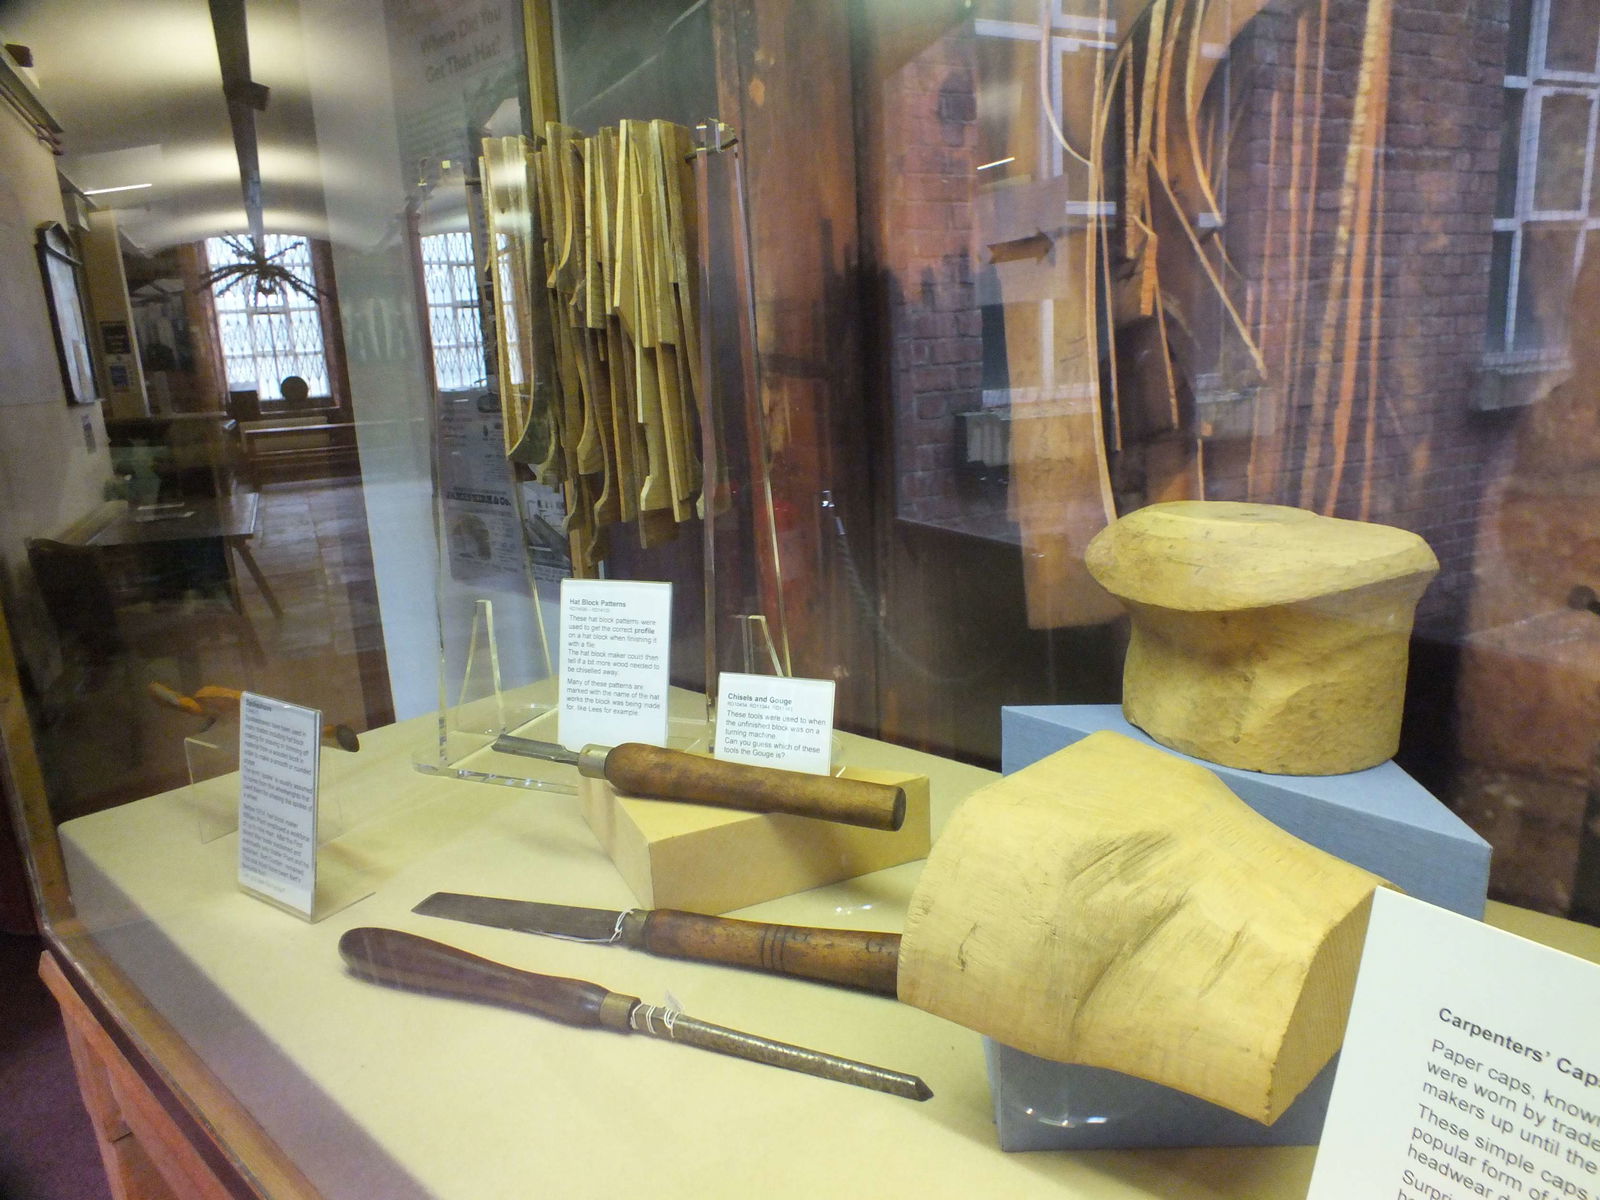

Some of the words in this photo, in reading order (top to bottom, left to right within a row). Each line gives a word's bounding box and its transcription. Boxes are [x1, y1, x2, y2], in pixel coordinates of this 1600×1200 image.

[728, 693, 752, 701] Chisels
[770, 697, 792, 706] Gouge
[738, 721, 770, 729] unfinished
[725, 729, 746, 737] turning
[753, 749, 774, 758] Gouge
[1427, 1060, 1468, 1088] were
[1474, 1082, 1517, 1111] worn
[1523, 1102, 1546, 1127] by
[1432, 1039, 1482, 1073] Paper
[1488, 1066, 1535, 1099] caps,
[1557, 1057, 1600, 1089] Cap
[1418, 1103, 1470, 1140] These
[1475, 1133, 1535, 1174] simple
[1541, 1169, 1589, 1200] caps
[1422, 1080, 1485, 1119] makers
[1491, 1113, 1514, 1135] up
[1520, 1126, 1559, 1156] until
[1566, 1148, 1598, 1174] the
[1408, 1144, 1494, 1200] headwear
[1411, 1125, 1477, 1166] popular
[1481, 1160, 1522, 1191] form
